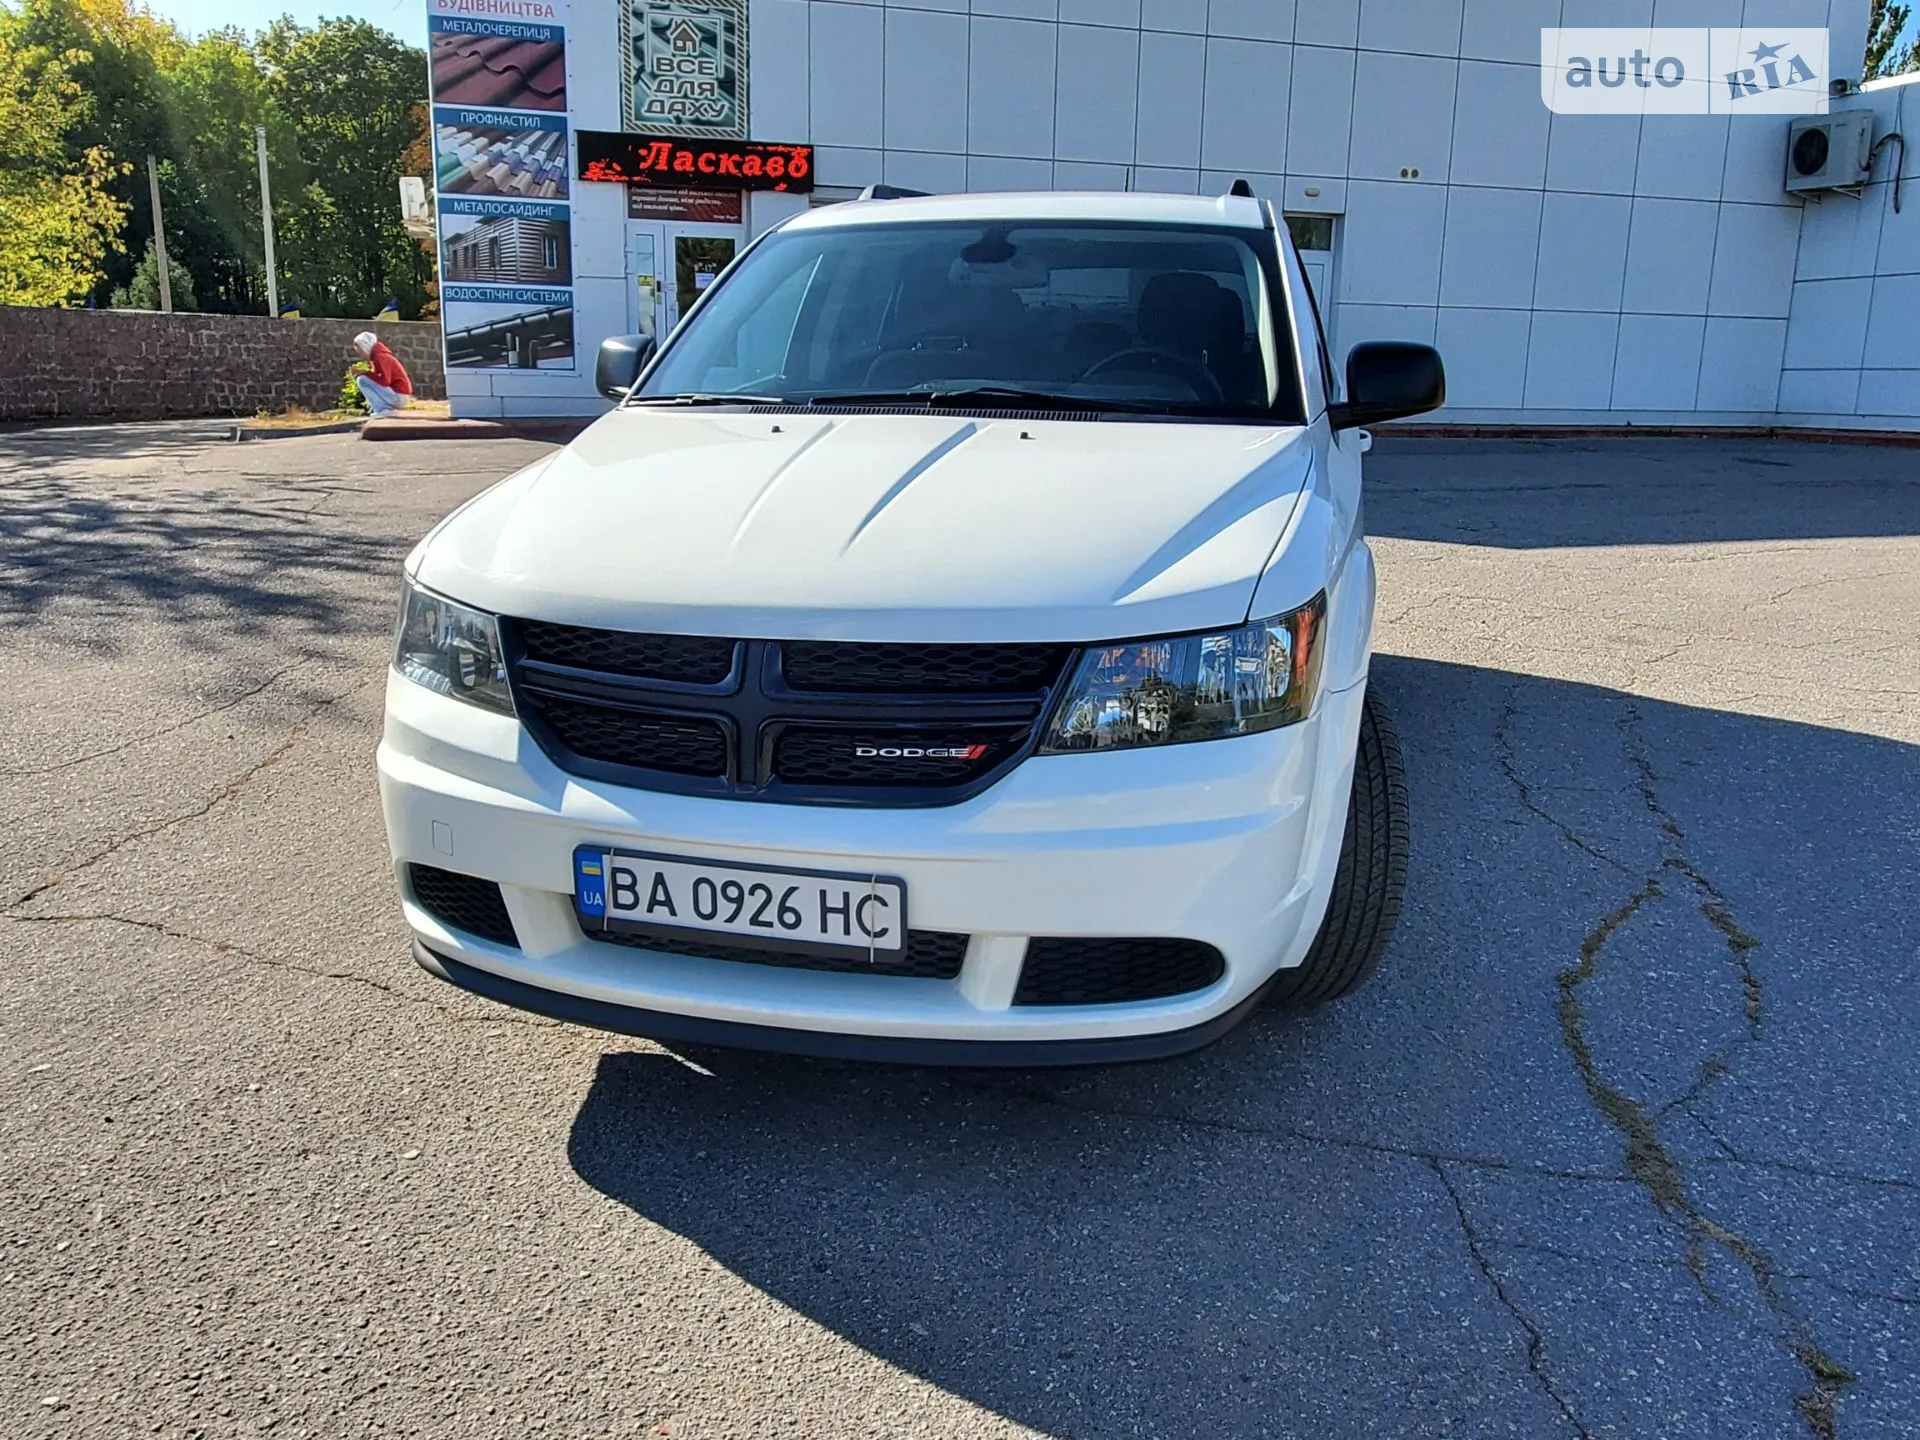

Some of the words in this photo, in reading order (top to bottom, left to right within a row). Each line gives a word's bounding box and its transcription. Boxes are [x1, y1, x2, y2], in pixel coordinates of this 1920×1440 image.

[442, 20, 551, 39] МЕТАЛОЧЕРЕПИЦЯ
[655, 56, 716, 76] ВСЕ
[653, 79, 716, 97] ДЛЯ
[644, 99, 727, 118] ДАХУ
[460, 111, 541, 128] ПРОФНАСТИЛ
[453, 201, 555, 217] МЕТАЛОСАЙДИНГ
[445, 287, 514, 300] ВОДОСТІЧНІ
[515, 290, 570, 302] СИСТЕМИ
[856, 747, 969, 758] DODGE
[583, 891, 604, 906] UA
[611, 866, 678, 917] BA
[692, 876, 803, 931] 0926
[818, 888, 890, 939] HC
